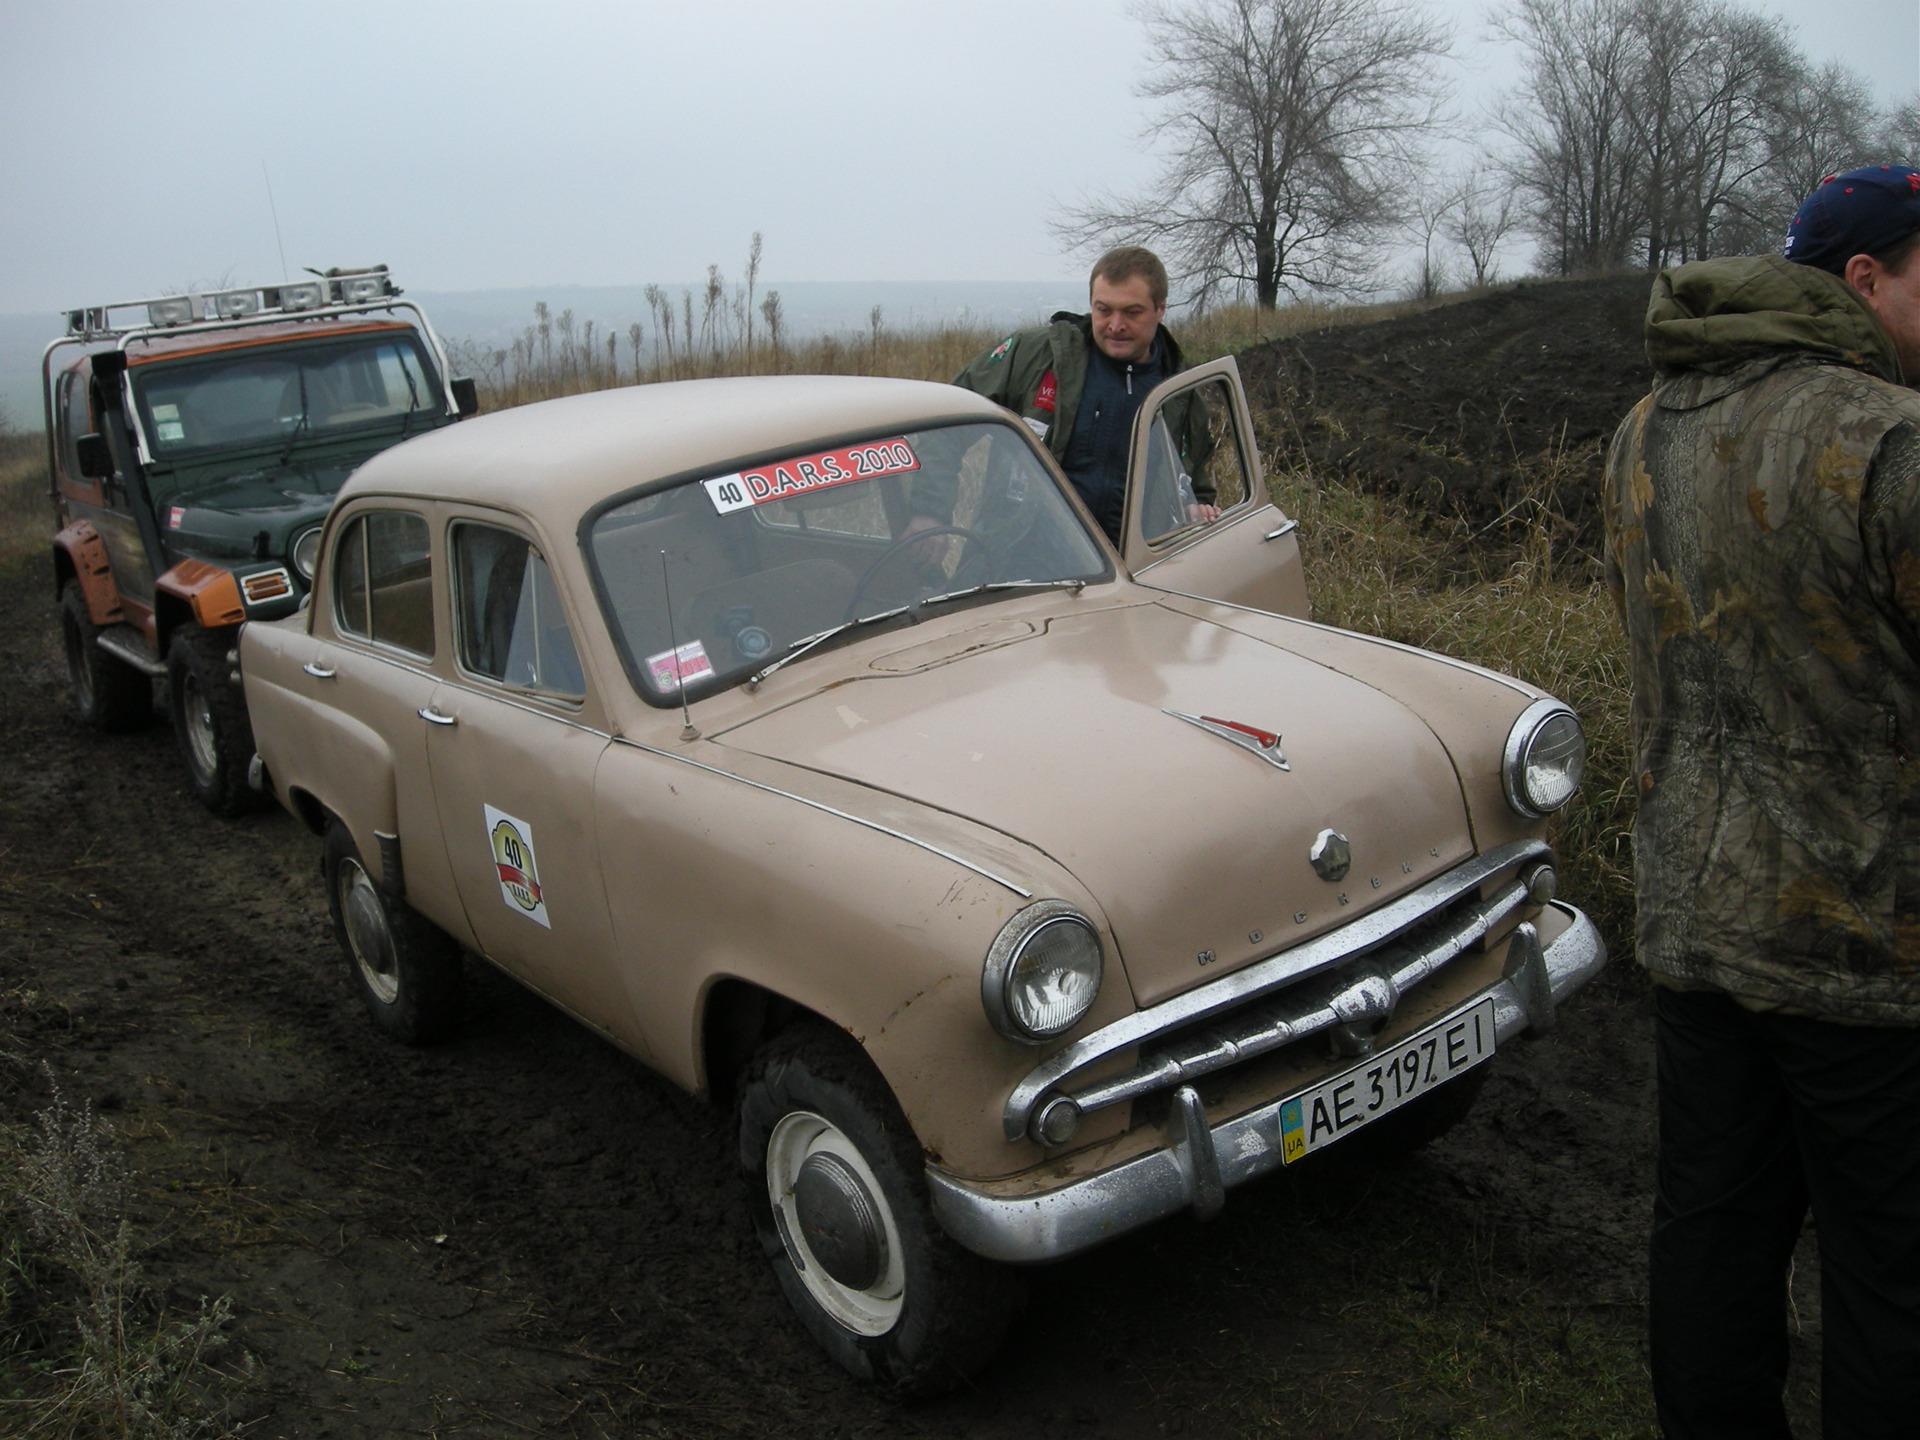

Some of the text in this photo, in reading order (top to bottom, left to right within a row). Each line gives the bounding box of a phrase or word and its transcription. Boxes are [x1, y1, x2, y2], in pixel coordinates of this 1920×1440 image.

[718, 443, 914, 505] 40 D.A.R.S. 2010
[504, 835, 523, 870] 40
[1309, 1079, 1359, 1144] AE
[1366, 1037, 1437, 1112] 3197
[1287, 1137, 1304, 1155] UA
